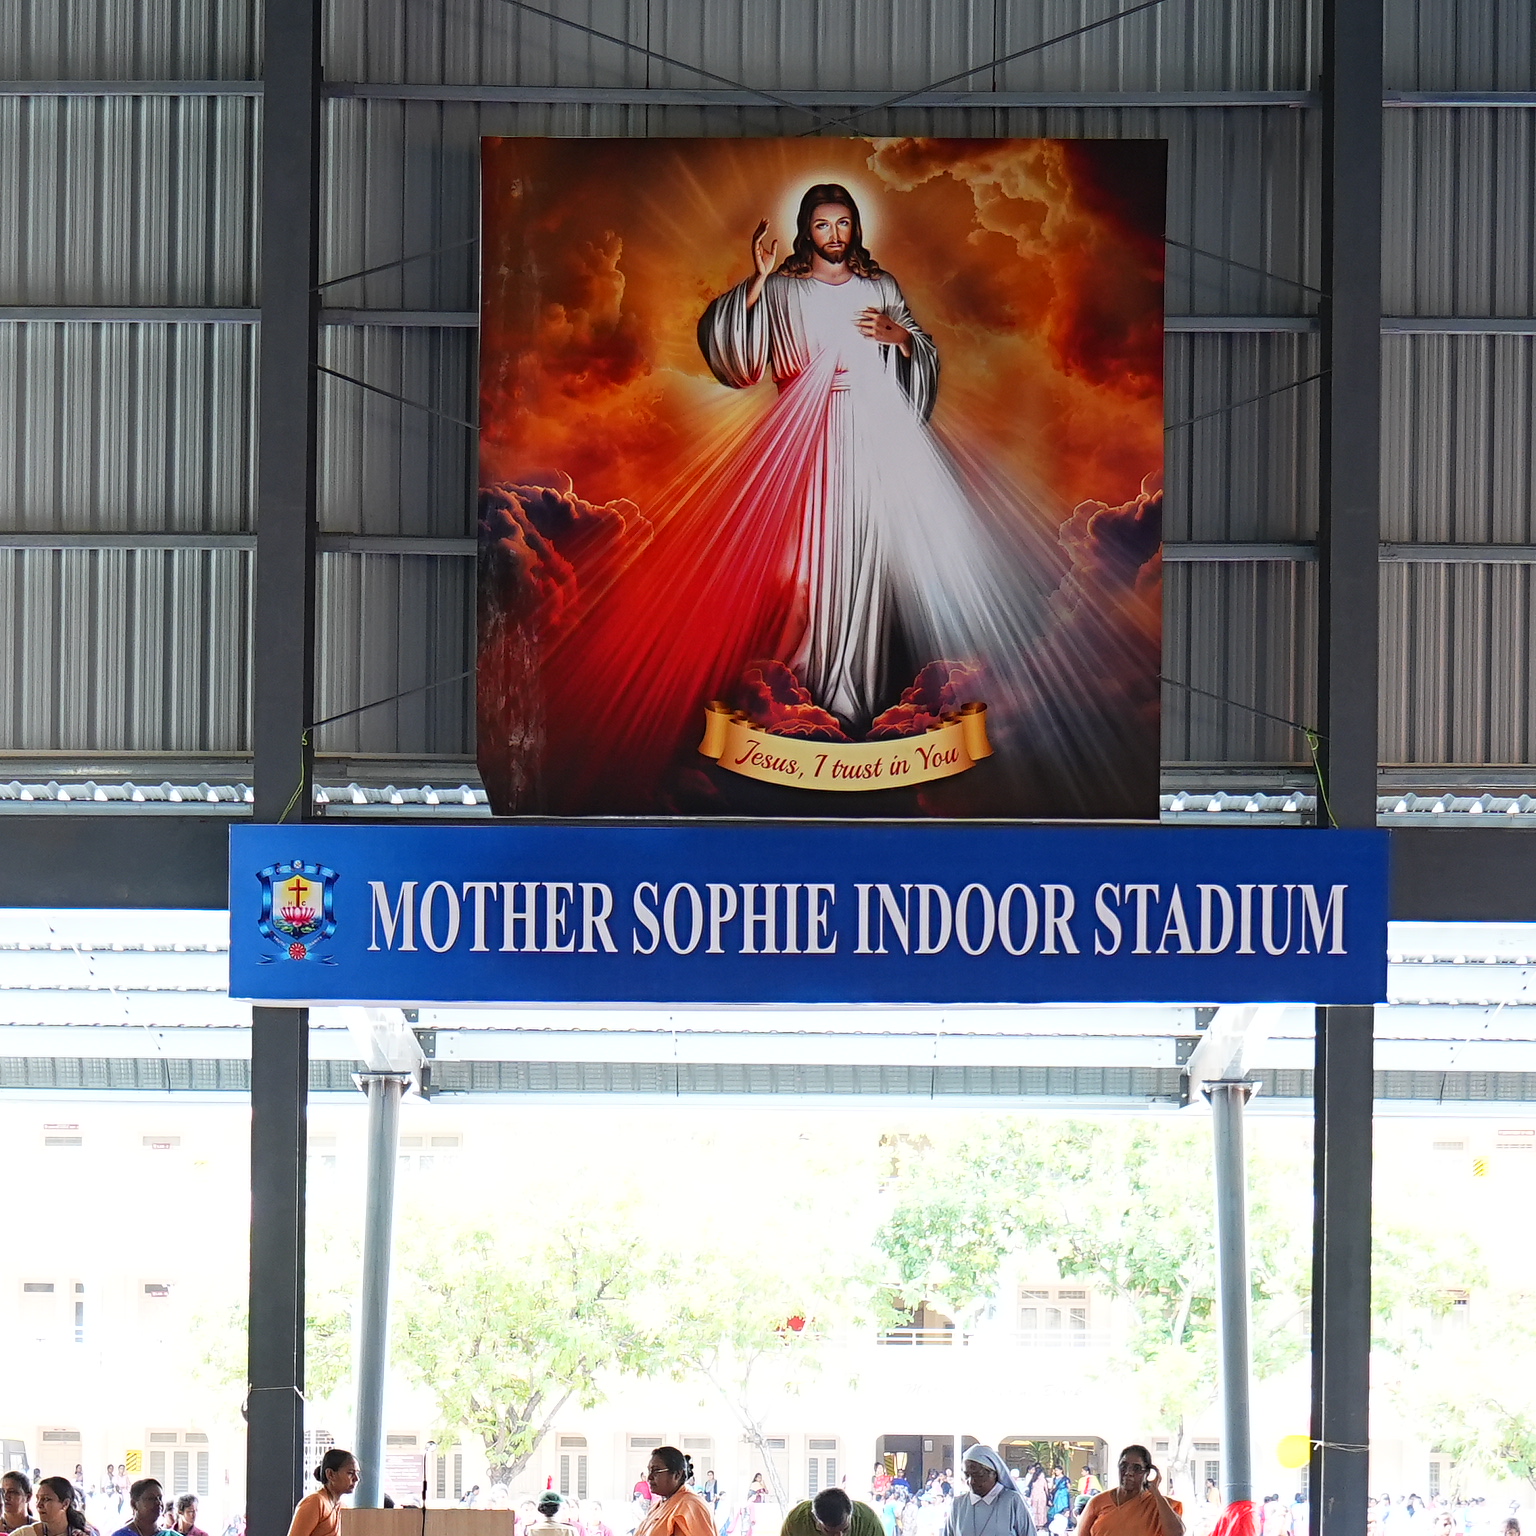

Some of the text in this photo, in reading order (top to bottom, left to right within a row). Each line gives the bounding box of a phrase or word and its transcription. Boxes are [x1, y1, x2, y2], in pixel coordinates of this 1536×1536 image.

[734, 739, 804, 780] Jesus,
[831, 755, 882, 779] trust
[889, 755, 911, 775] in
[915, 743, 960, 771] You
[367, 880, 1349, 957] MOTHER SOPHIE INDOOR STADIUM
